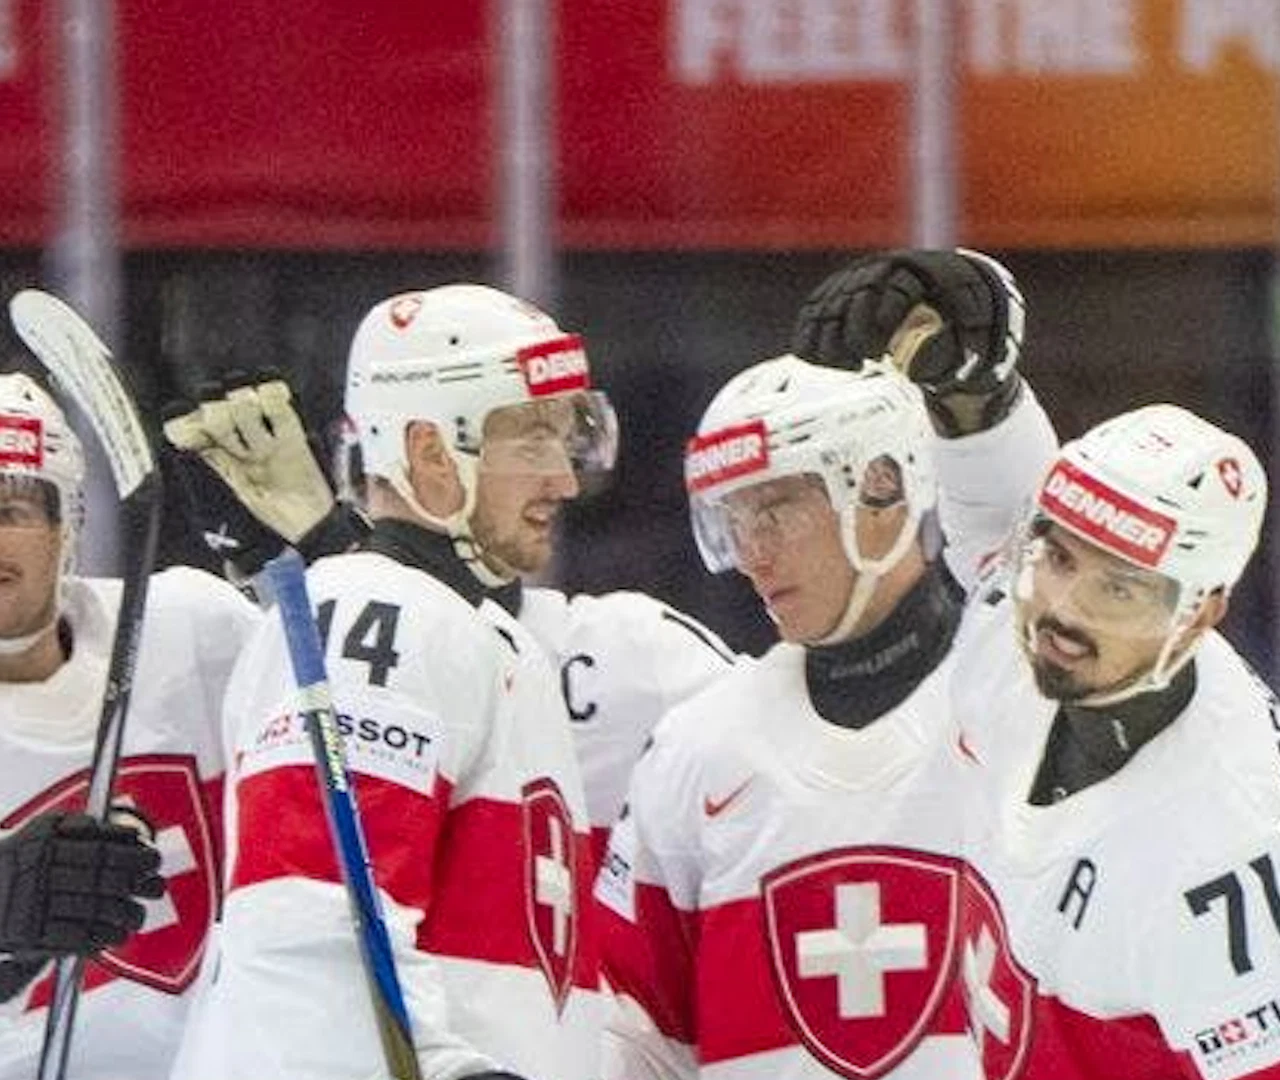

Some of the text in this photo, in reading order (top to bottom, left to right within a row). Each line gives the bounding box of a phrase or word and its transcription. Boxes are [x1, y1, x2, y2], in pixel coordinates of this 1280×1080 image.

[1045, 470, 1168, 550] DENNER
[561, 653, 598, 722] C
[297, 709, 432, 758] TSSOT
[1056, 857, 1098, 932] A
